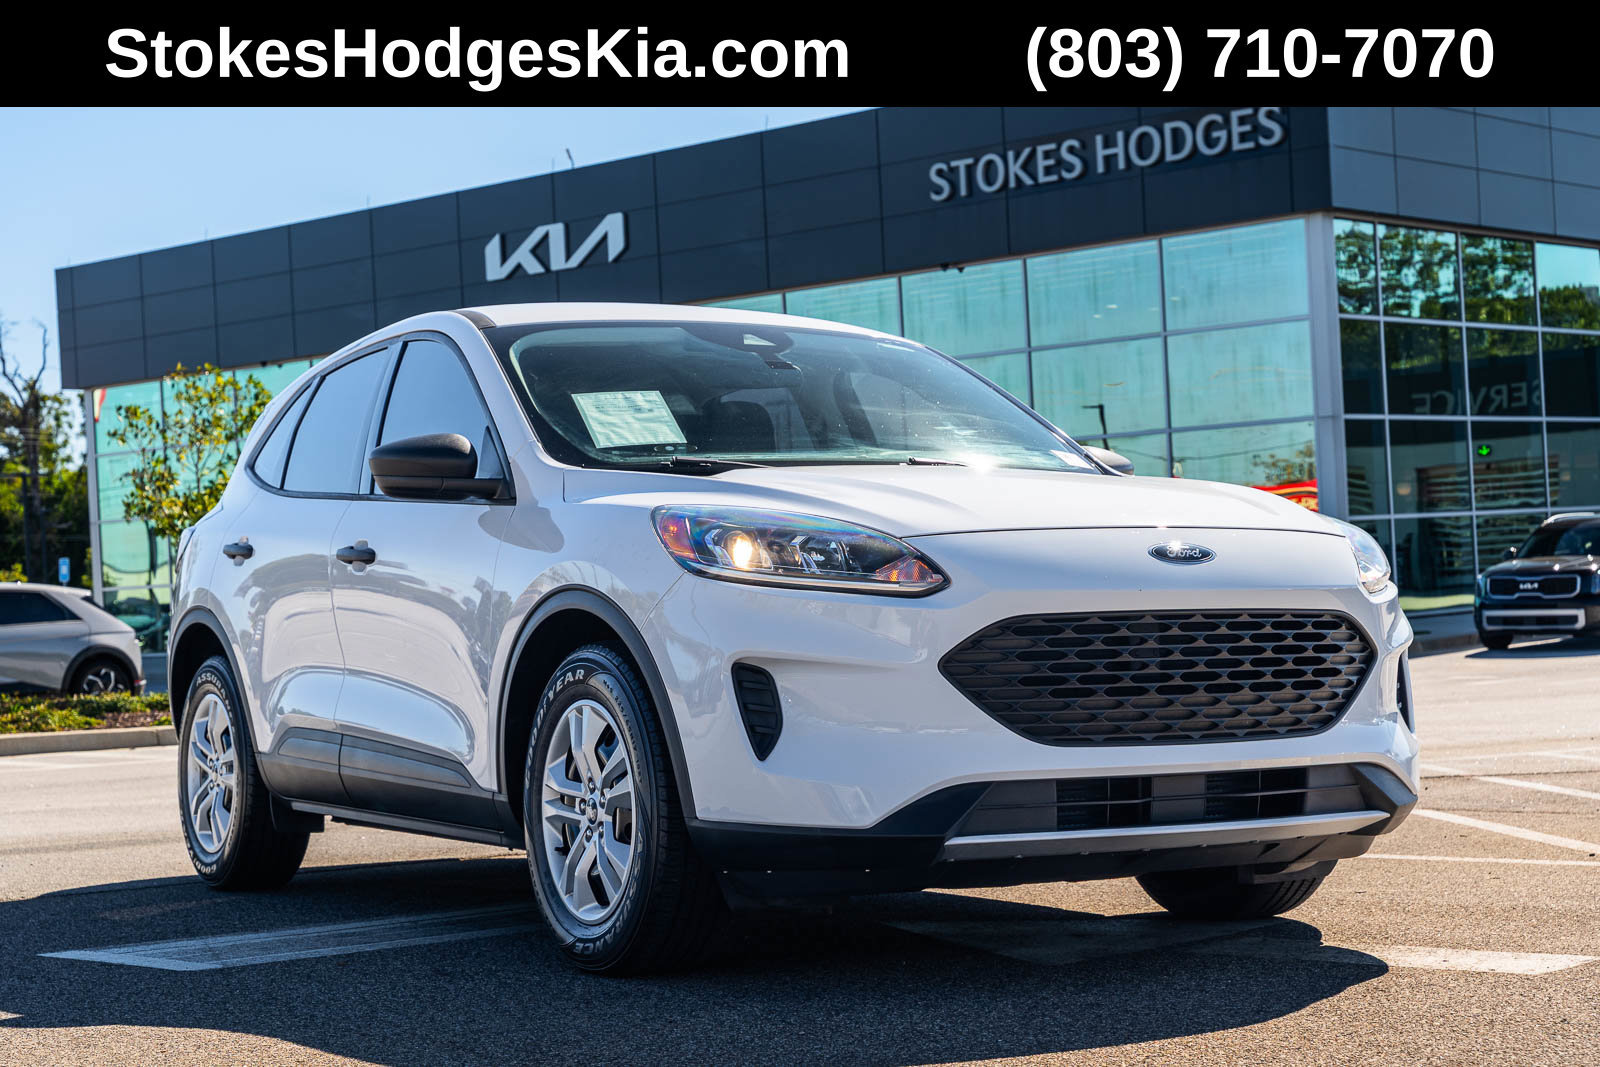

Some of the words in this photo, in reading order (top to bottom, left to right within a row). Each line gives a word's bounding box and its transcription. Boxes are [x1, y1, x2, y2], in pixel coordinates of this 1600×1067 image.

[929, 139, 1084, 201] STOKES
[1095, 107, 1284, 173] HODGES
[485, 212, 626, 281] KIA
